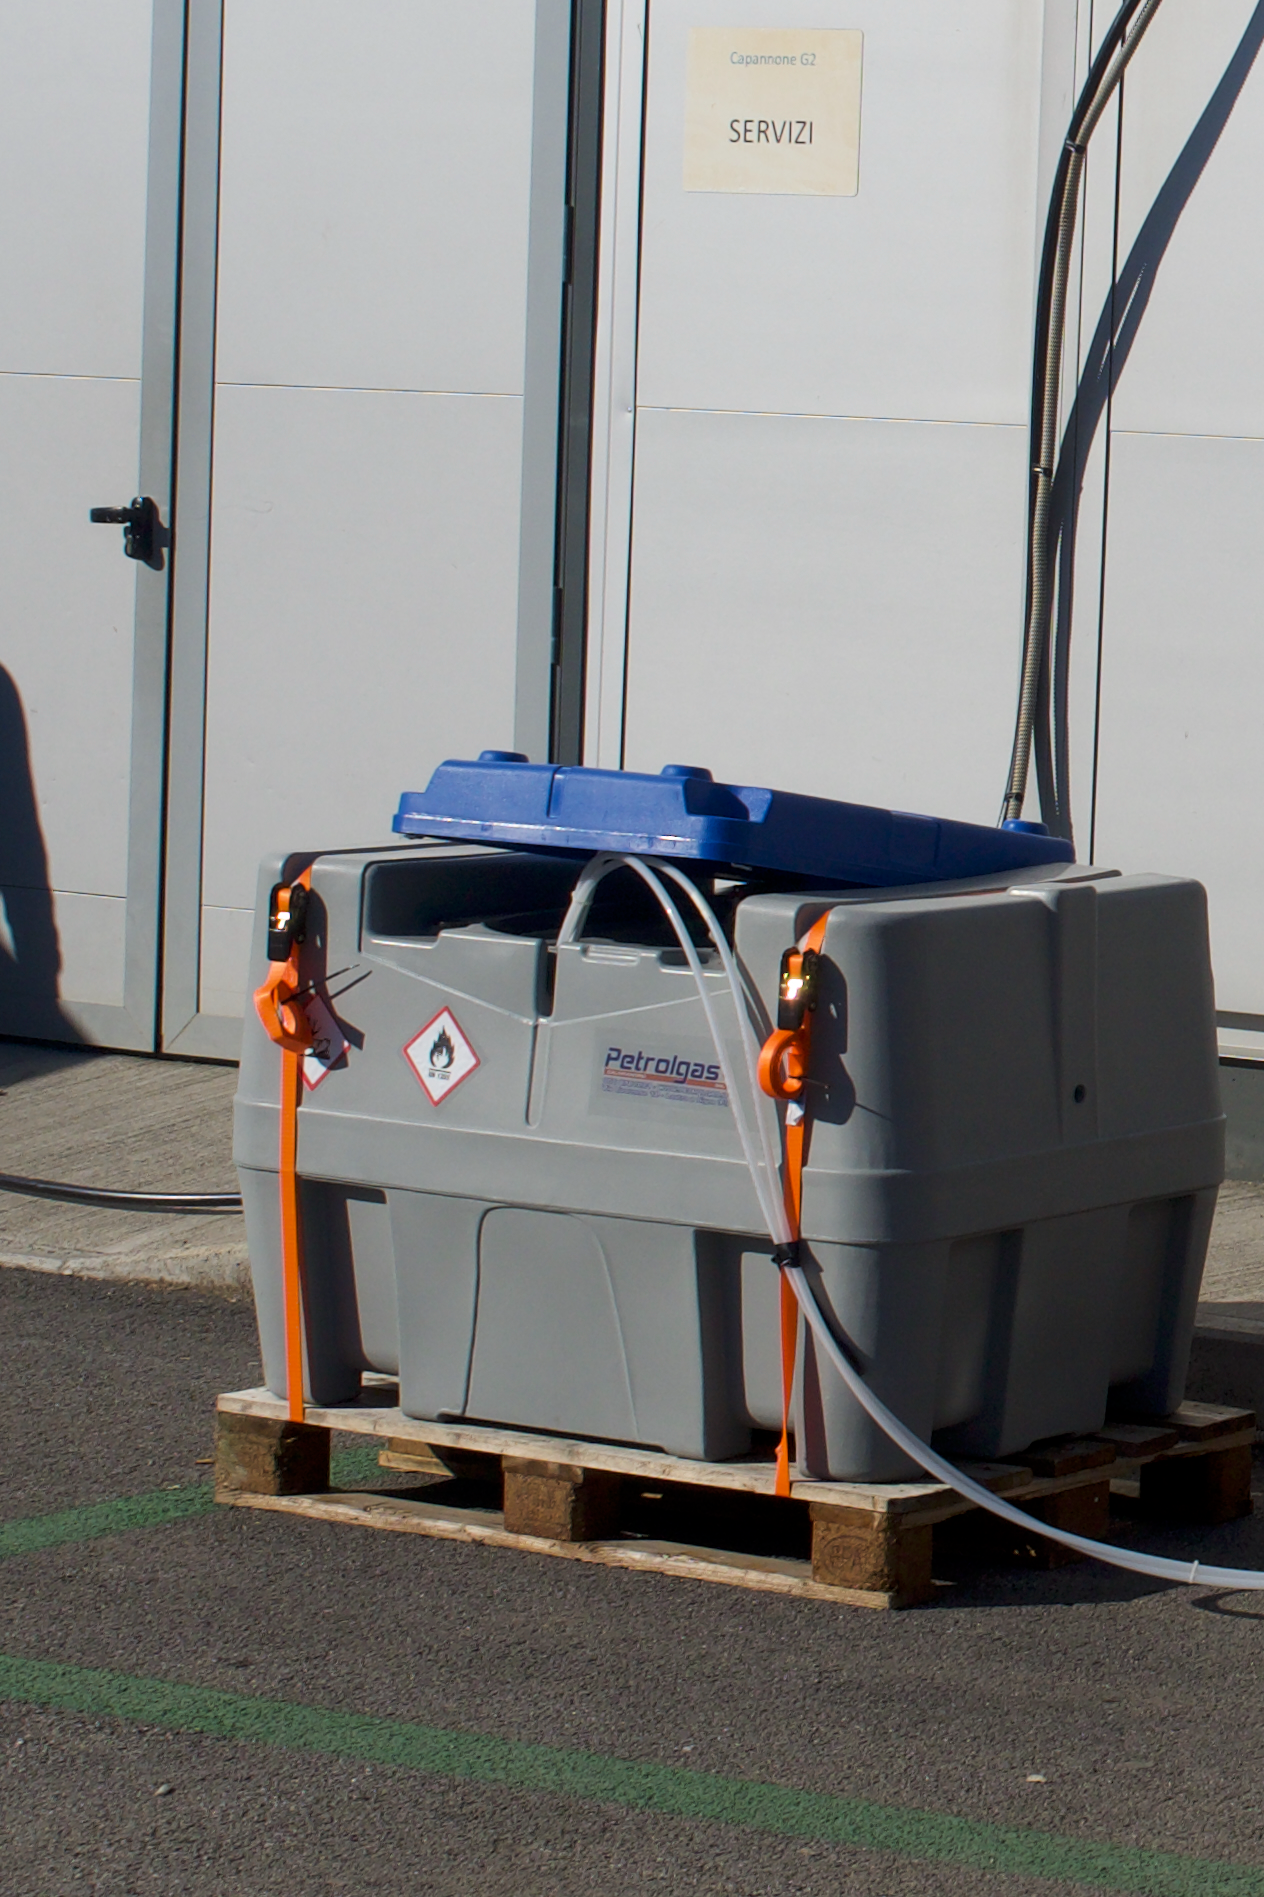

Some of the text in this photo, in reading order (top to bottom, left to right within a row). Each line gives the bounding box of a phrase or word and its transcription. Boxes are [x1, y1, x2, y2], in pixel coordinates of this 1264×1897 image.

[730, 51, 816, 67] Capannone G2
[729, 119, 813, 145] SERVIZI
[604, 1047, 721, 1084] Petrolgas
